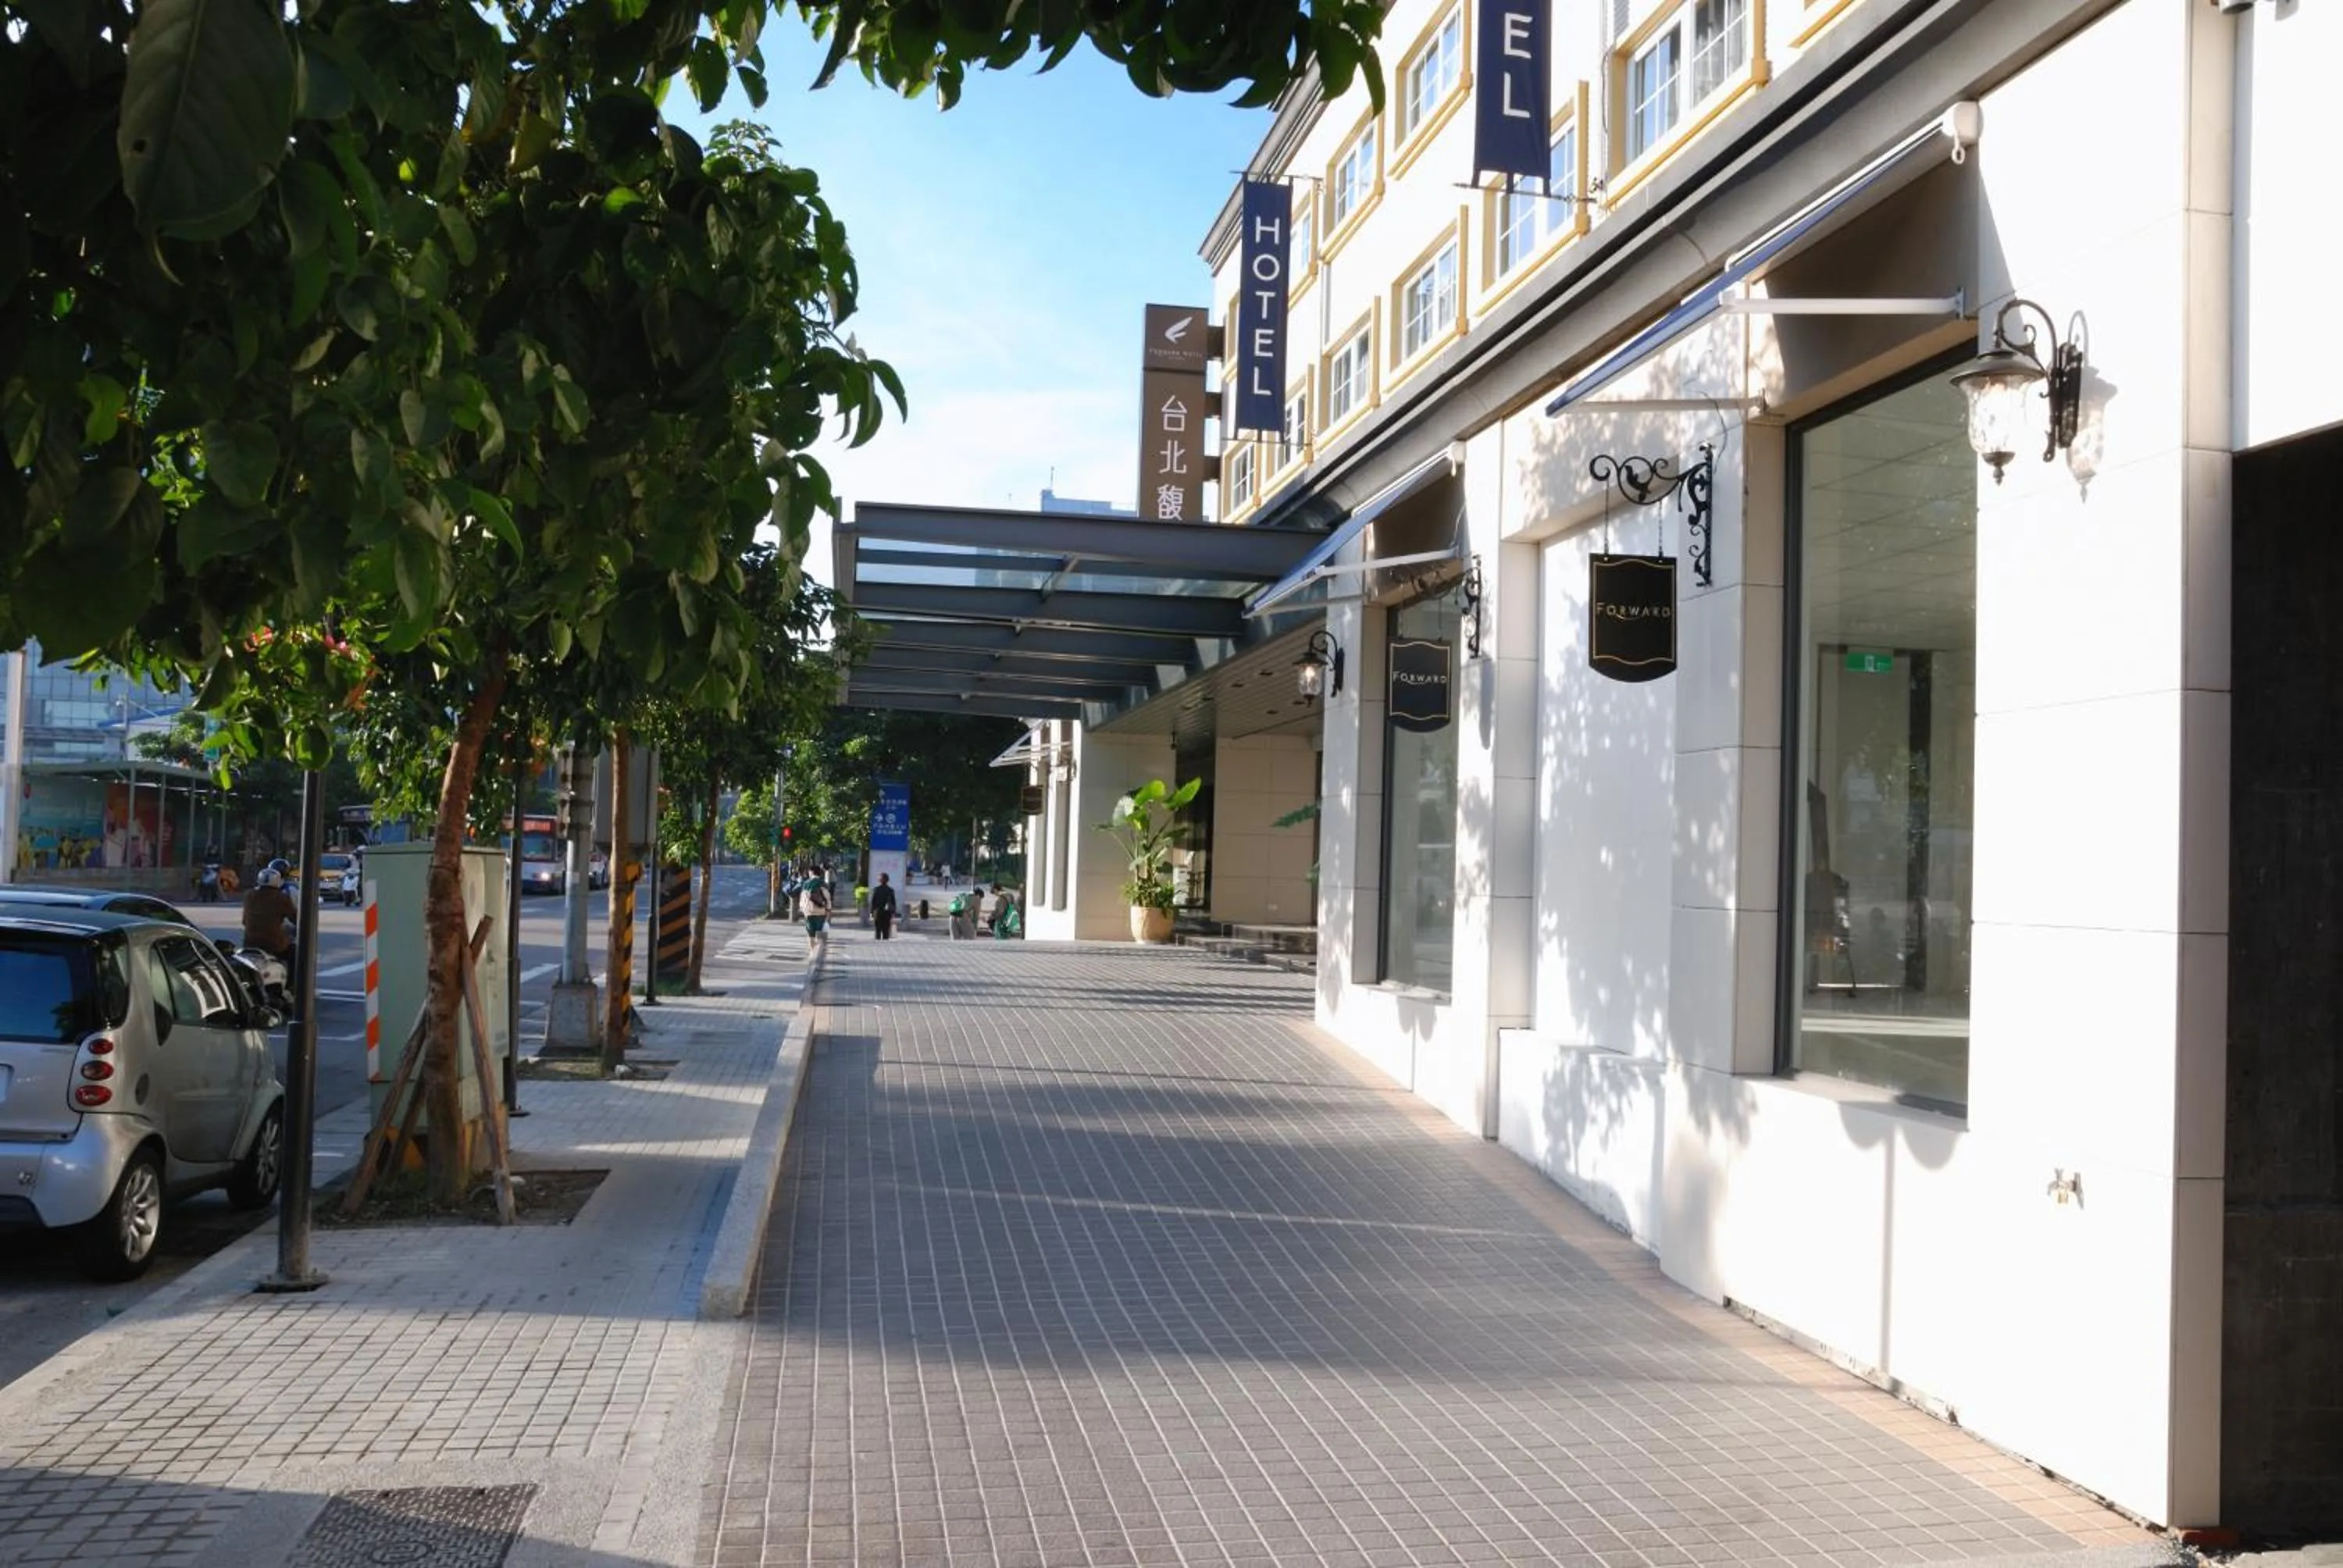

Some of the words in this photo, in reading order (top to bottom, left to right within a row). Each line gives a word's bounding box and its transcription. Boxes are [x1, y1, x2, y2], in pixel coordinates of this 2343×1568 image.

[1252, 215, 1280, 396] HOTEL
[1157, 394, 1188, 522] 台北馥
